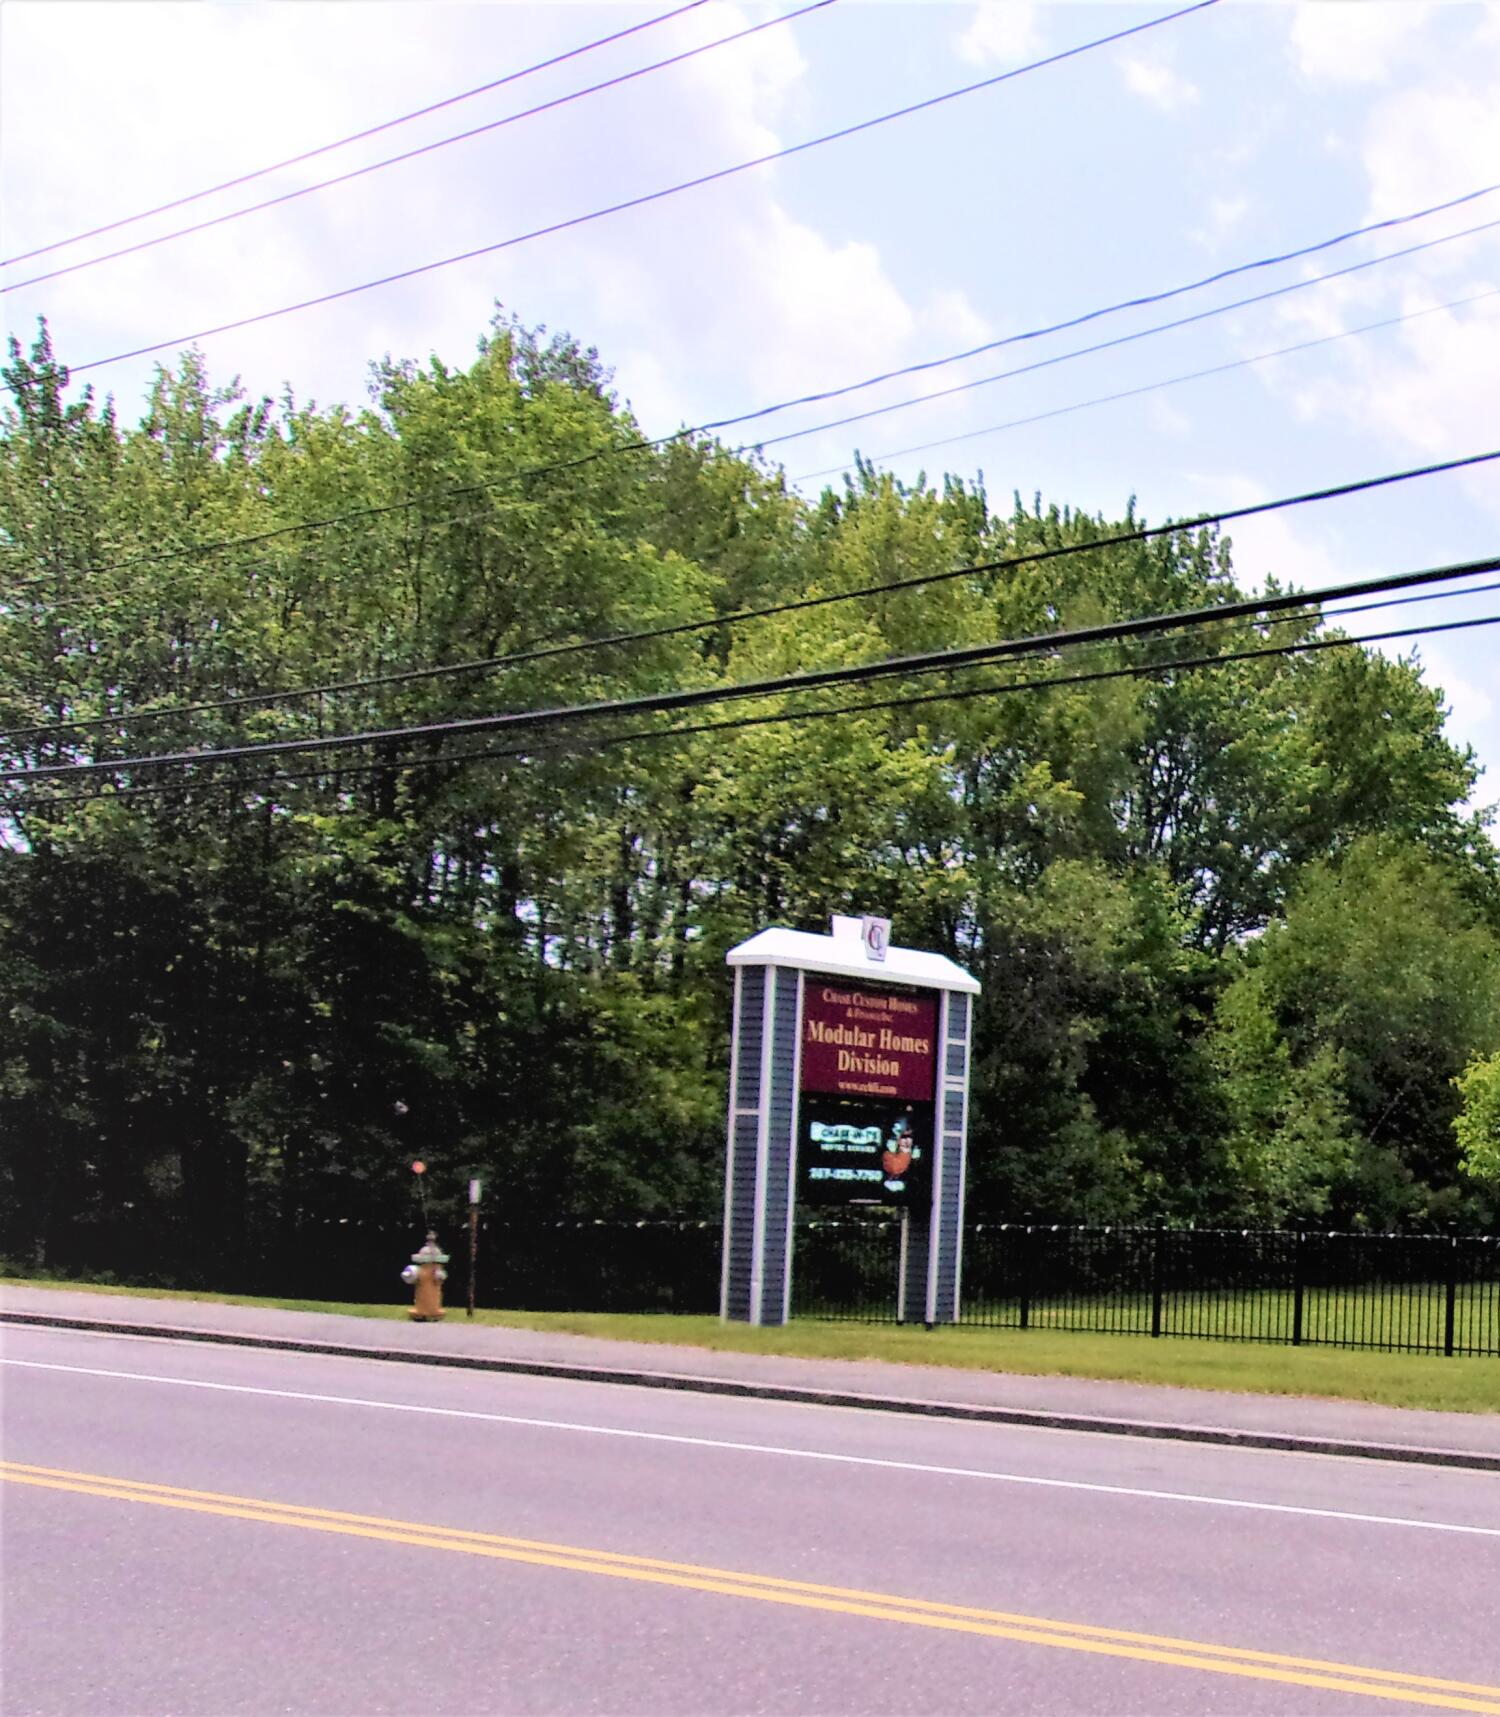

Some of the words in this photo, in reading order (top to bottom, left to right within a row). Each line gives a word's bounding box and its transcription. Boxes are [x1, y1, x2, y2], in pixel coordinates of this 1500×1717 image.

[808, 1020, 876, 1049] Modular
[879, 1028, 929, 1054] Homes
[838, 1050, 899, 1077] Division
